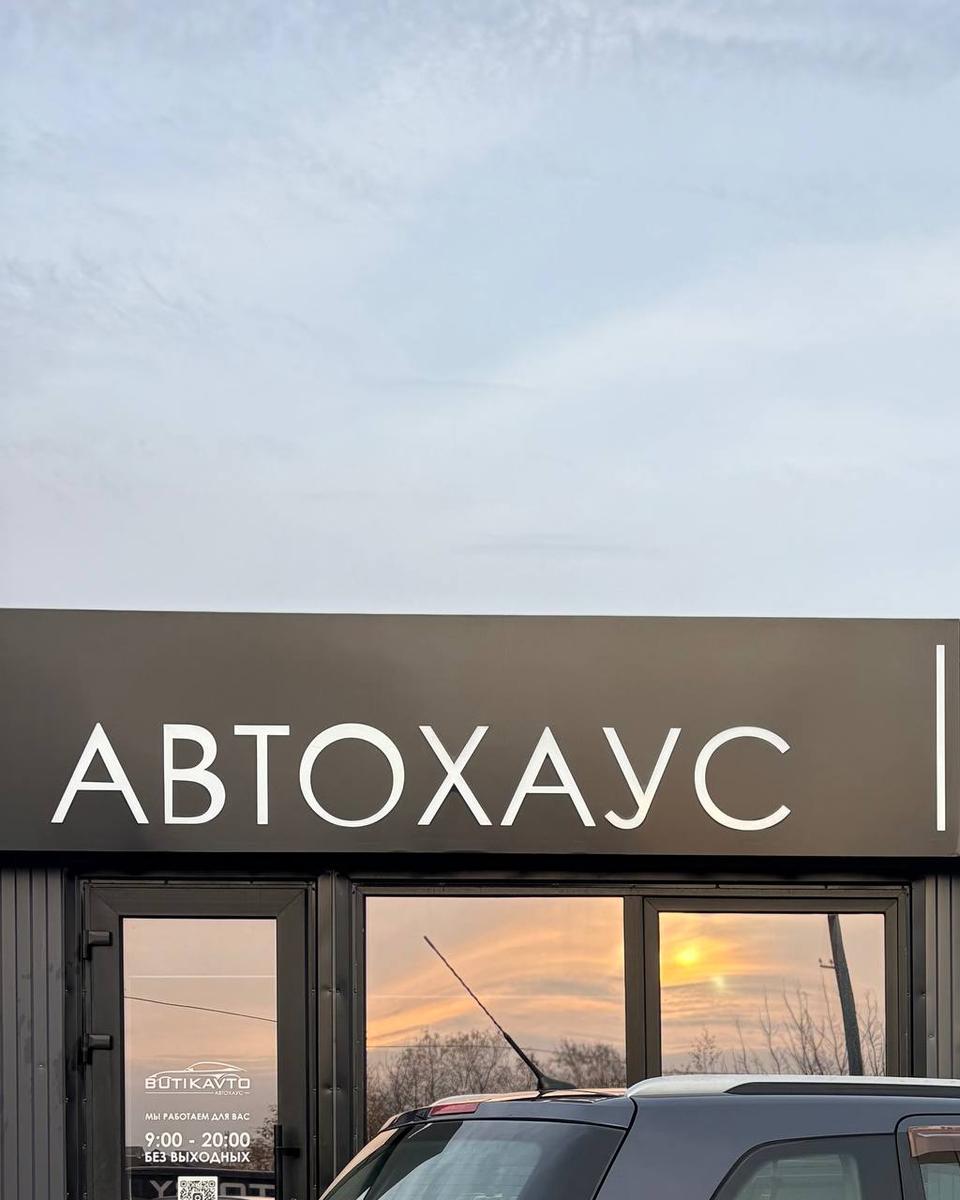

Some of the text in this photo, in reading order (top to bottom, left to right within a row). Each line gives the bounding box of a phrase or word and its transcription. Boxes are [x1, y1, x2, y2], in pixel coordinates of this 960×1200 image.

[50, 721, 792, 831] АВТОХАУС
[145, 1077, 251, 1089] BUTIKAVTO
[145, 1113, 250, 1121] МЫ РАБОТАЕМ ДЛЯ ВАС
[145, 1132, 183, 1148] 9:00
[201, 1132, 251, 1148] 20:00
[145, 1152, 251, 1164] БЕЗ ВЫХОДНЫХ
